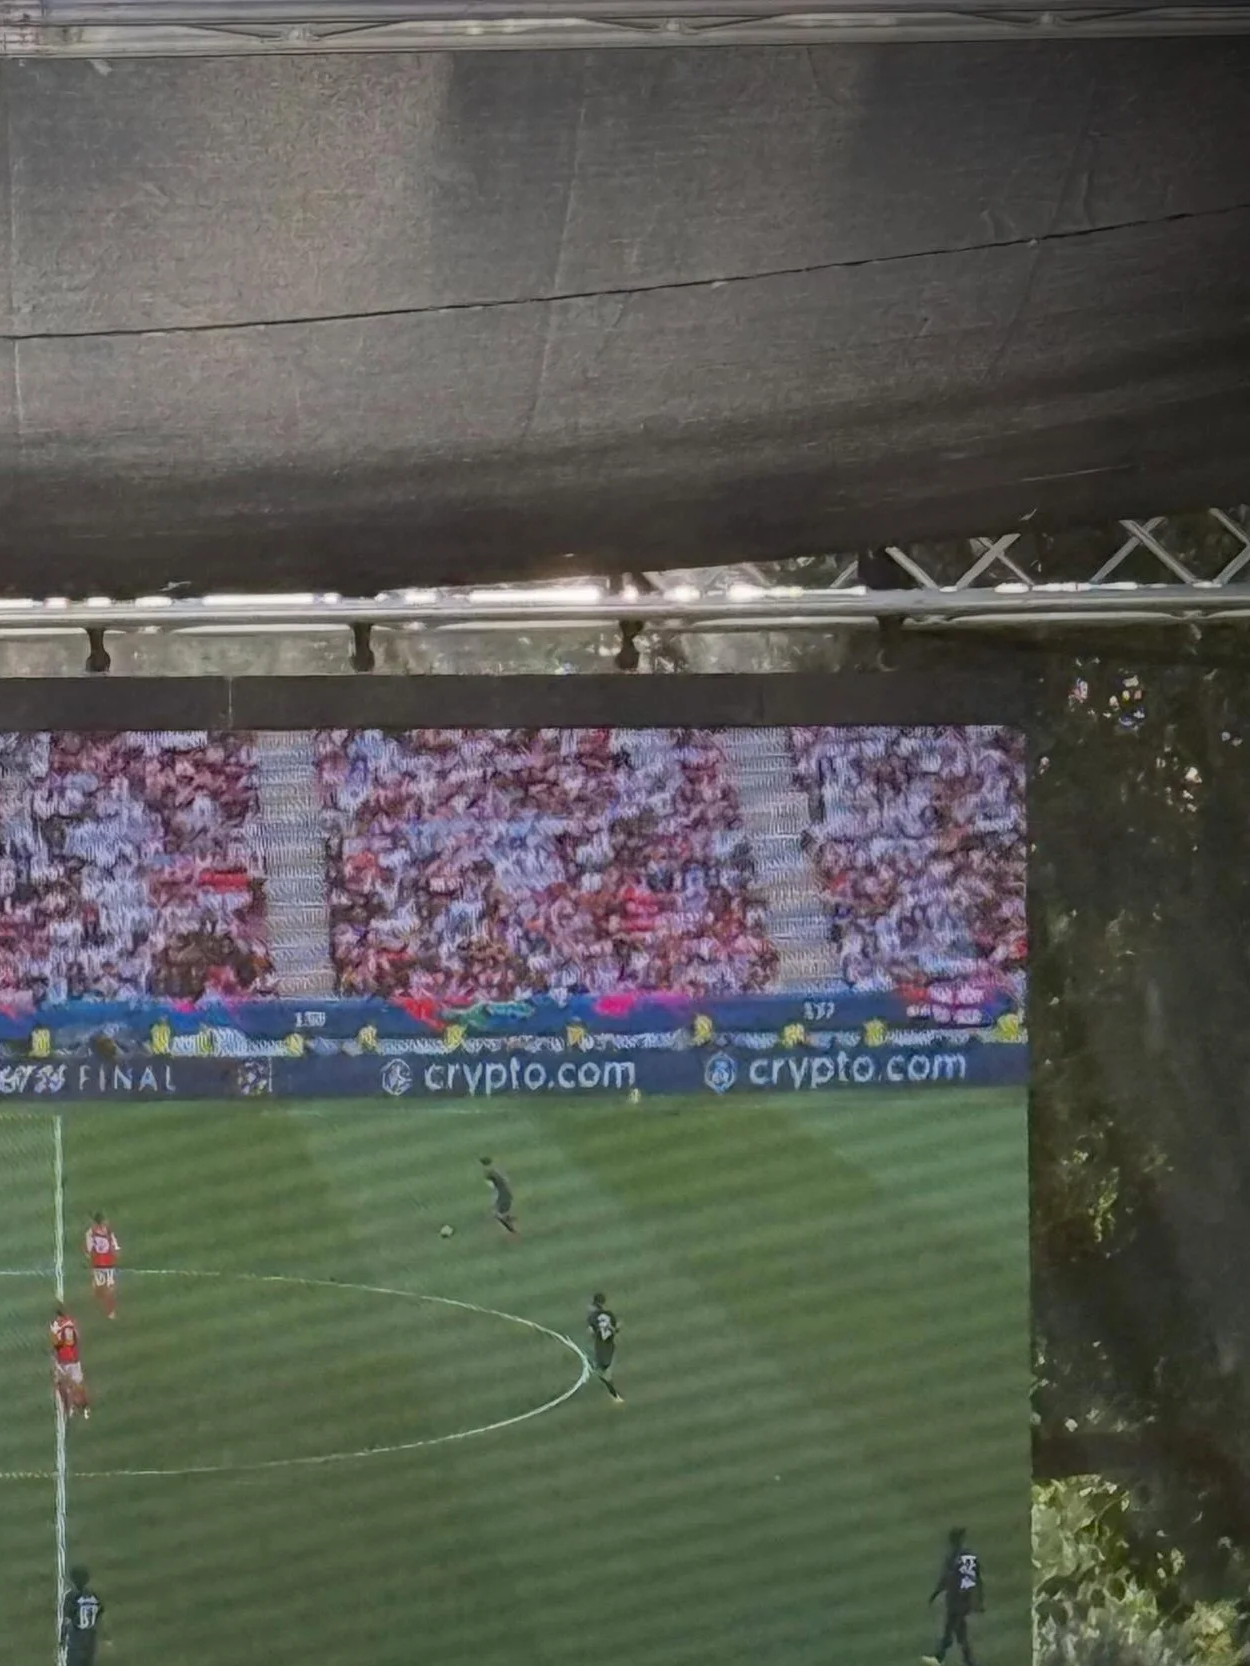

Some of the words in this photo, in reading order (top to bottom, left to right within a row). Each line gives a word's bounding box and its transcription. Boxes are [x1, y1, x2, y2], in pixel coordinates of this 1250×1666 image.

[78, 1063, 177, 1093] FINAL
[424, 1056, 636, 1096] crypto.com
[749, 1050, 967, 1090] crypto.com
